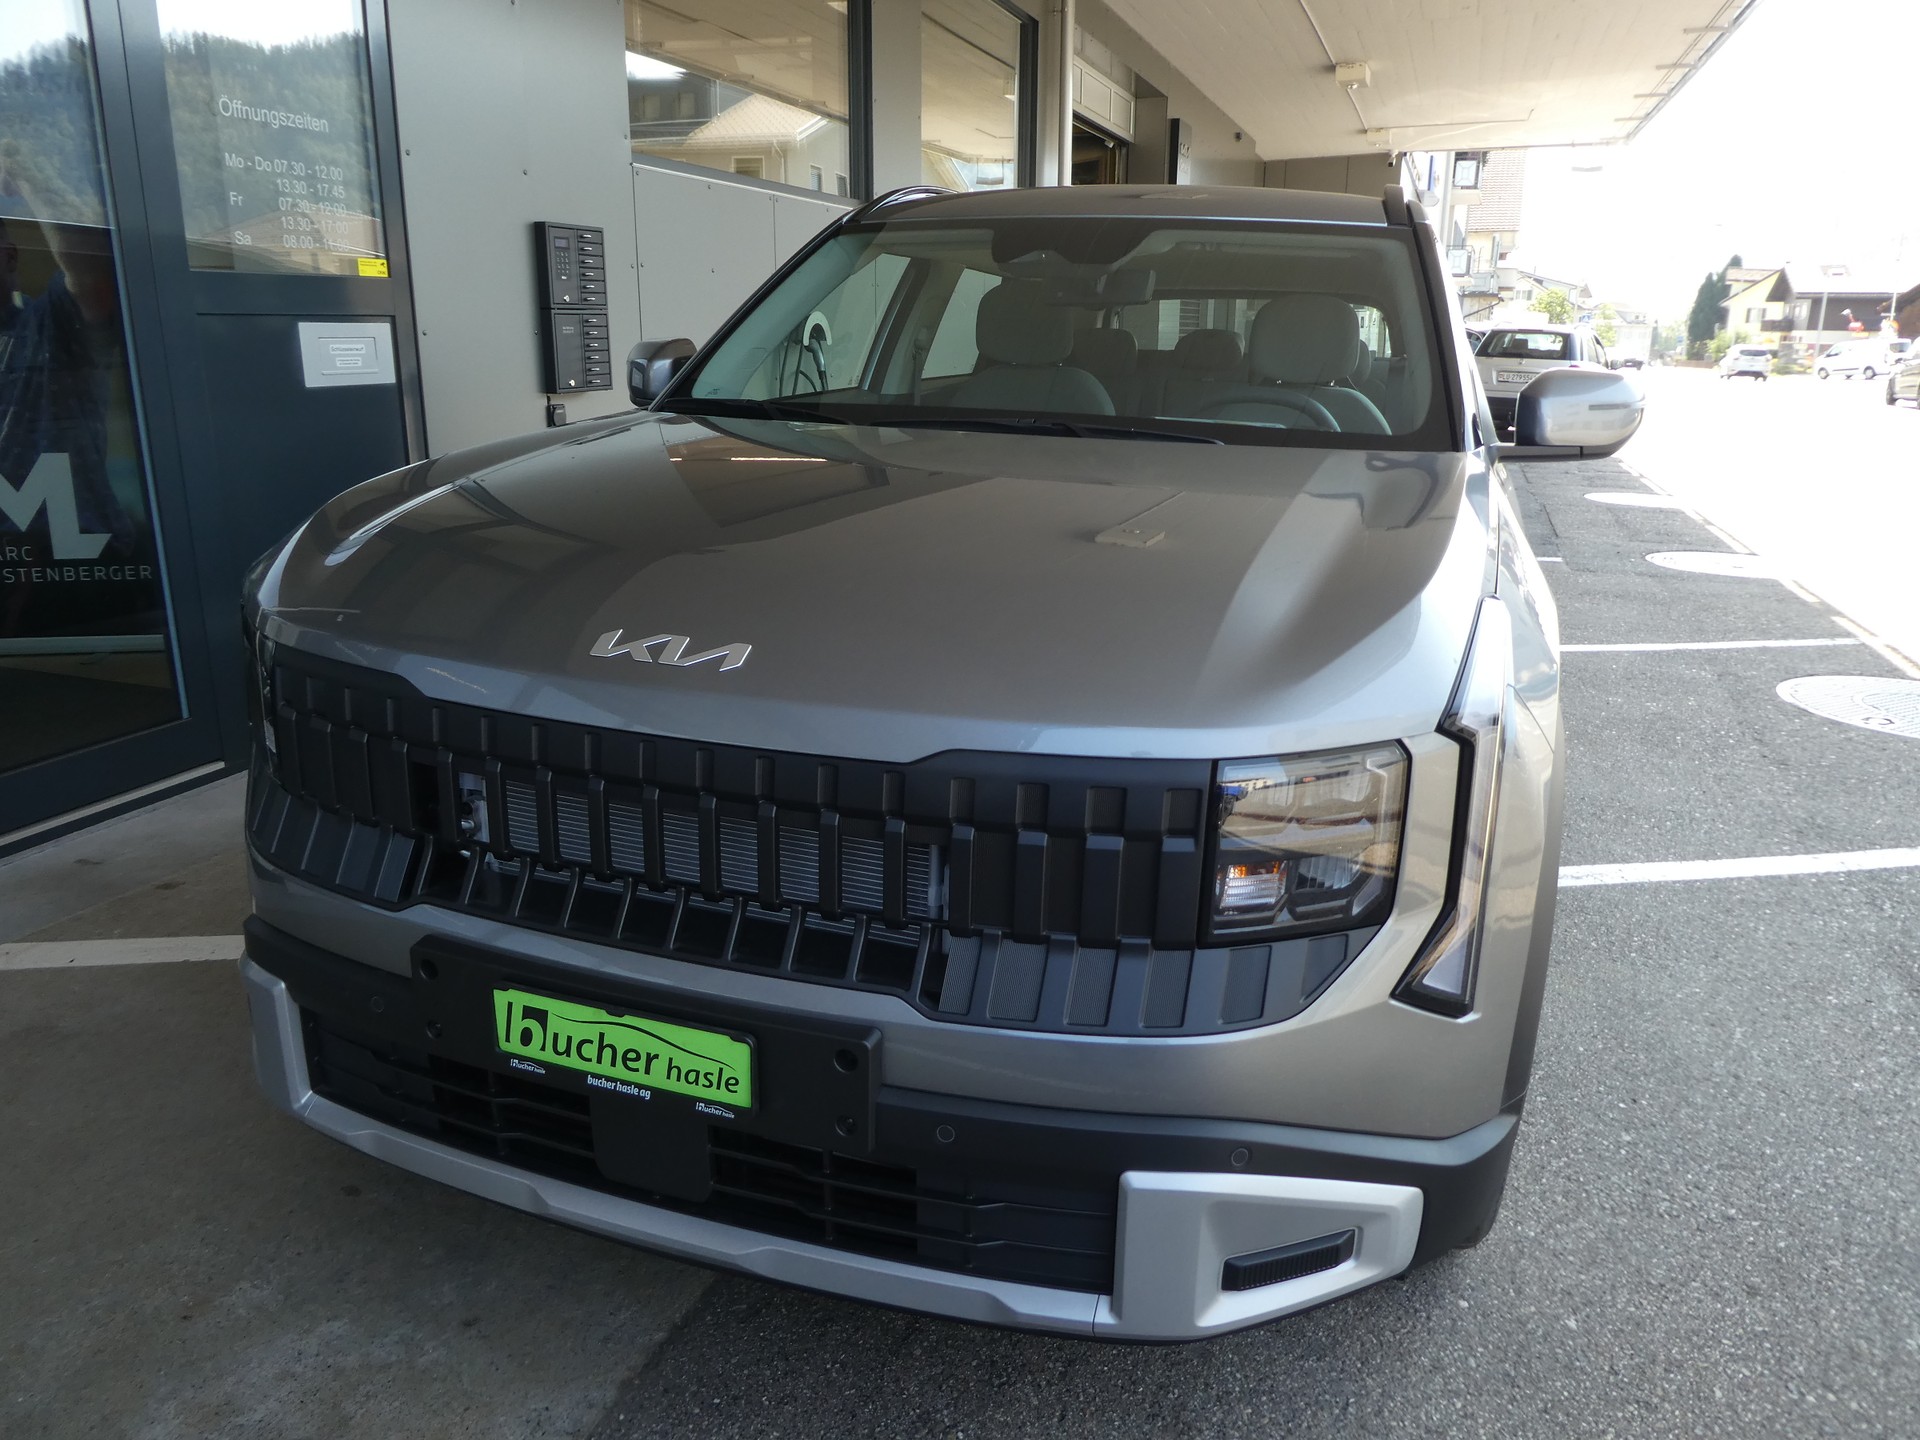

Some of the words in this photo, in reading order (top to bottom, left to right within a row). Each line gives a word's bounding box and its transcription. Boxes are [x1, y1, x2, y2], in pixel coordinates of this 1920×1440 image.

[219, 95, 329, 133] Öffnungszeiten
[225, 152, 244, 168] Mo
[255, 156, 272, 172] Do
[274, 159, 305, 176] 07.30
[315, 165, 343, 181] 12.00
[276, 179, 307, 194] 13.30
[317, 183, 345, 199] 17.45
[229, 191, 243, 206] Fr
[279, 197, 310, 213] 07.30
[319, 201, 346, 217] 12.00
[281, 216, 311, 231] 13.30
[321, 220, 349, 235] 17.00
[234, 230, 252, 246] Sa
[283, 234, 313, 249] 08.00
[0, 546, 33, 561] RC
[3, 566, 152, 583] STENBERGER
[590, 628, 752, 672] KIA
[504, 1001, 660, 1075] bucher
[665, 1057, 740, 1094] hasle
[587, 1074, 616, 1090] bucher
[616, 1081, 639, 1095] hasle
[640, 1089, 651, 1100] ag
